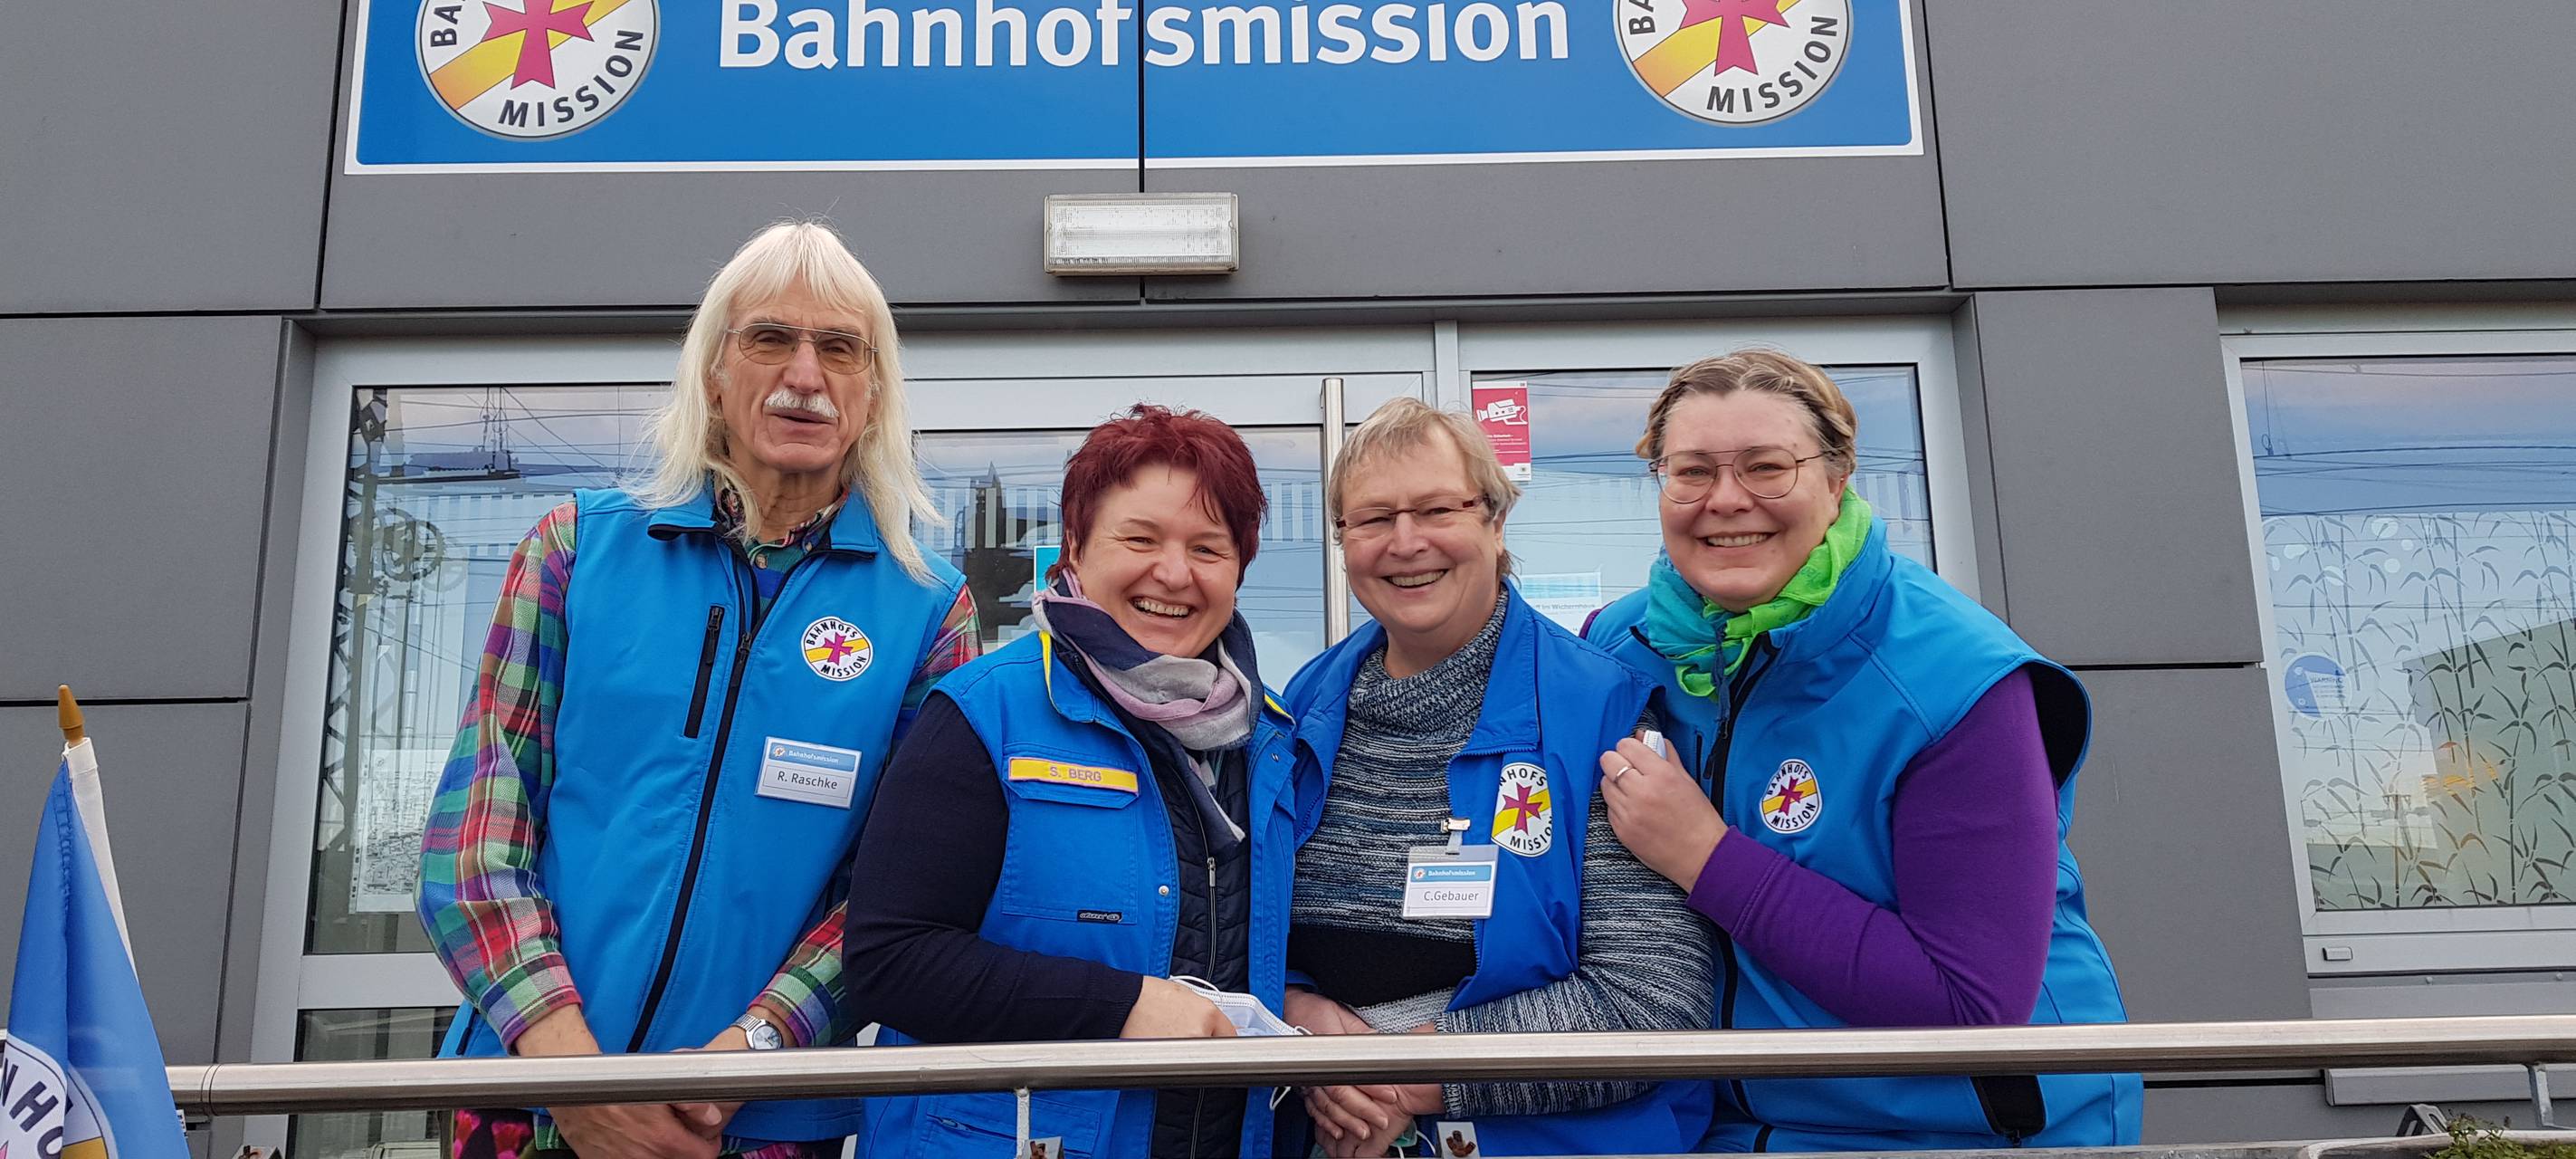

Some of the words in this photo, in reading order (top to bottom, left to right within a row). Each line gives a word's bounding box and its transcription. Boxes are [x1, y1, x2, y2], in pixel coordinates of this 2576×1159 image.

[720, 0, 1569, 70] Bahnhofsmission
[1707, 15, 1838, 113] MISSION
[498, 30, 644, 128] MISSION
[806, 620, 857, 645] BAHNHOFS
[821, 656, 866, 676] MISSION
[778, 771, 787, 781] R.
[791, 773, 837, 790] Raschke
[1050, 766, 1062, 778] S.
[1069, 769, 1102, 781] BERG
[1771, 802, 1816, 829] MISSION
[1510, 816, 1552, 850] MISSIO
[1424, 890, 1479, 901] C.Gebauer
